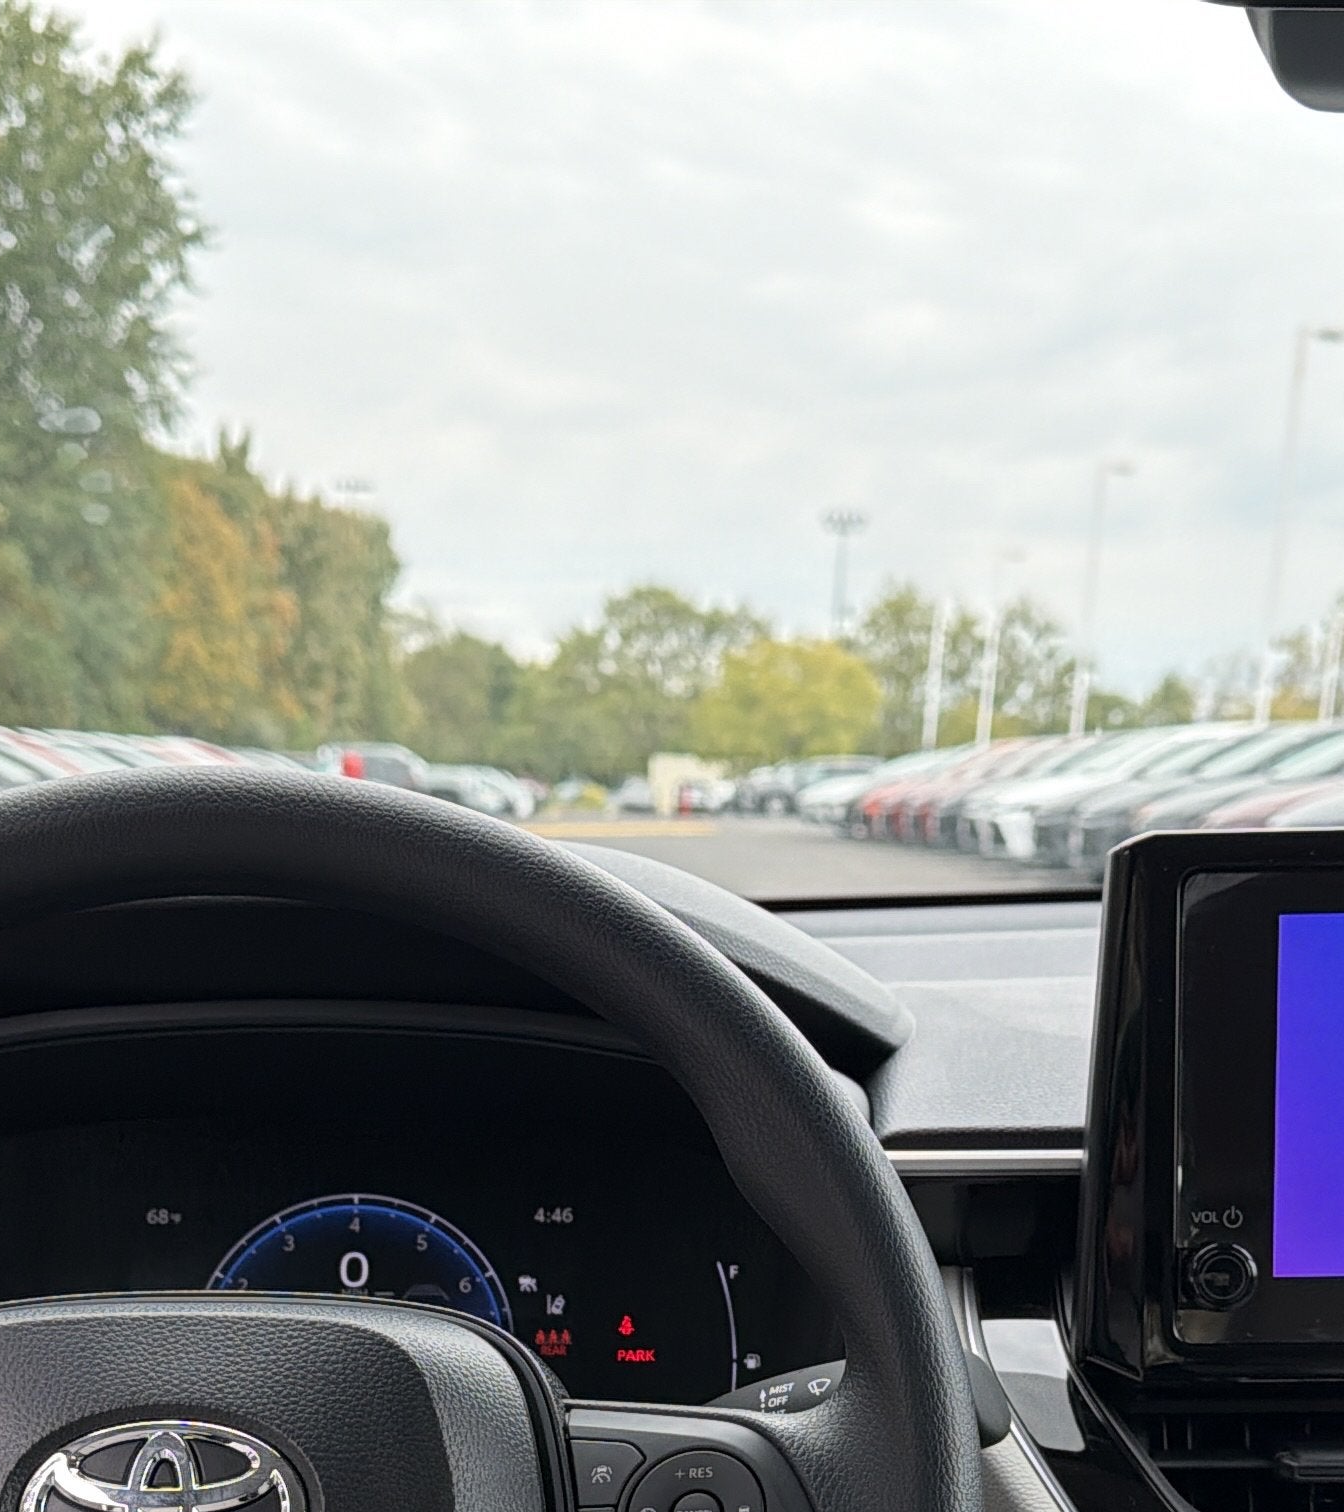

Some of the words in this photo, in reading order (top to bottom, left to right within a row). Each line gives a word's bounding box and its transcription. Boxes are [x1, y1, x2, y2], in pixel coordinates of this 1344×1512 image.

[534, 1207, 574, 1223] 4:46
[1191, 1211, 1219, 1223] VOL
[349, 1217, 360, 1232] 4
[284, 1235, 295, 1251] 3
[417, 1234, 428, 1251] 5
[340, 1251, 369, 1287] 0
[729, 1265, 739, 1279] F
[459, 1277, 471, 1292] 6
[617, 1349, 656, 1362] PARK
[768, 1395, 788, 1407] OFF
[689, 1467, 713, 1478] RES
